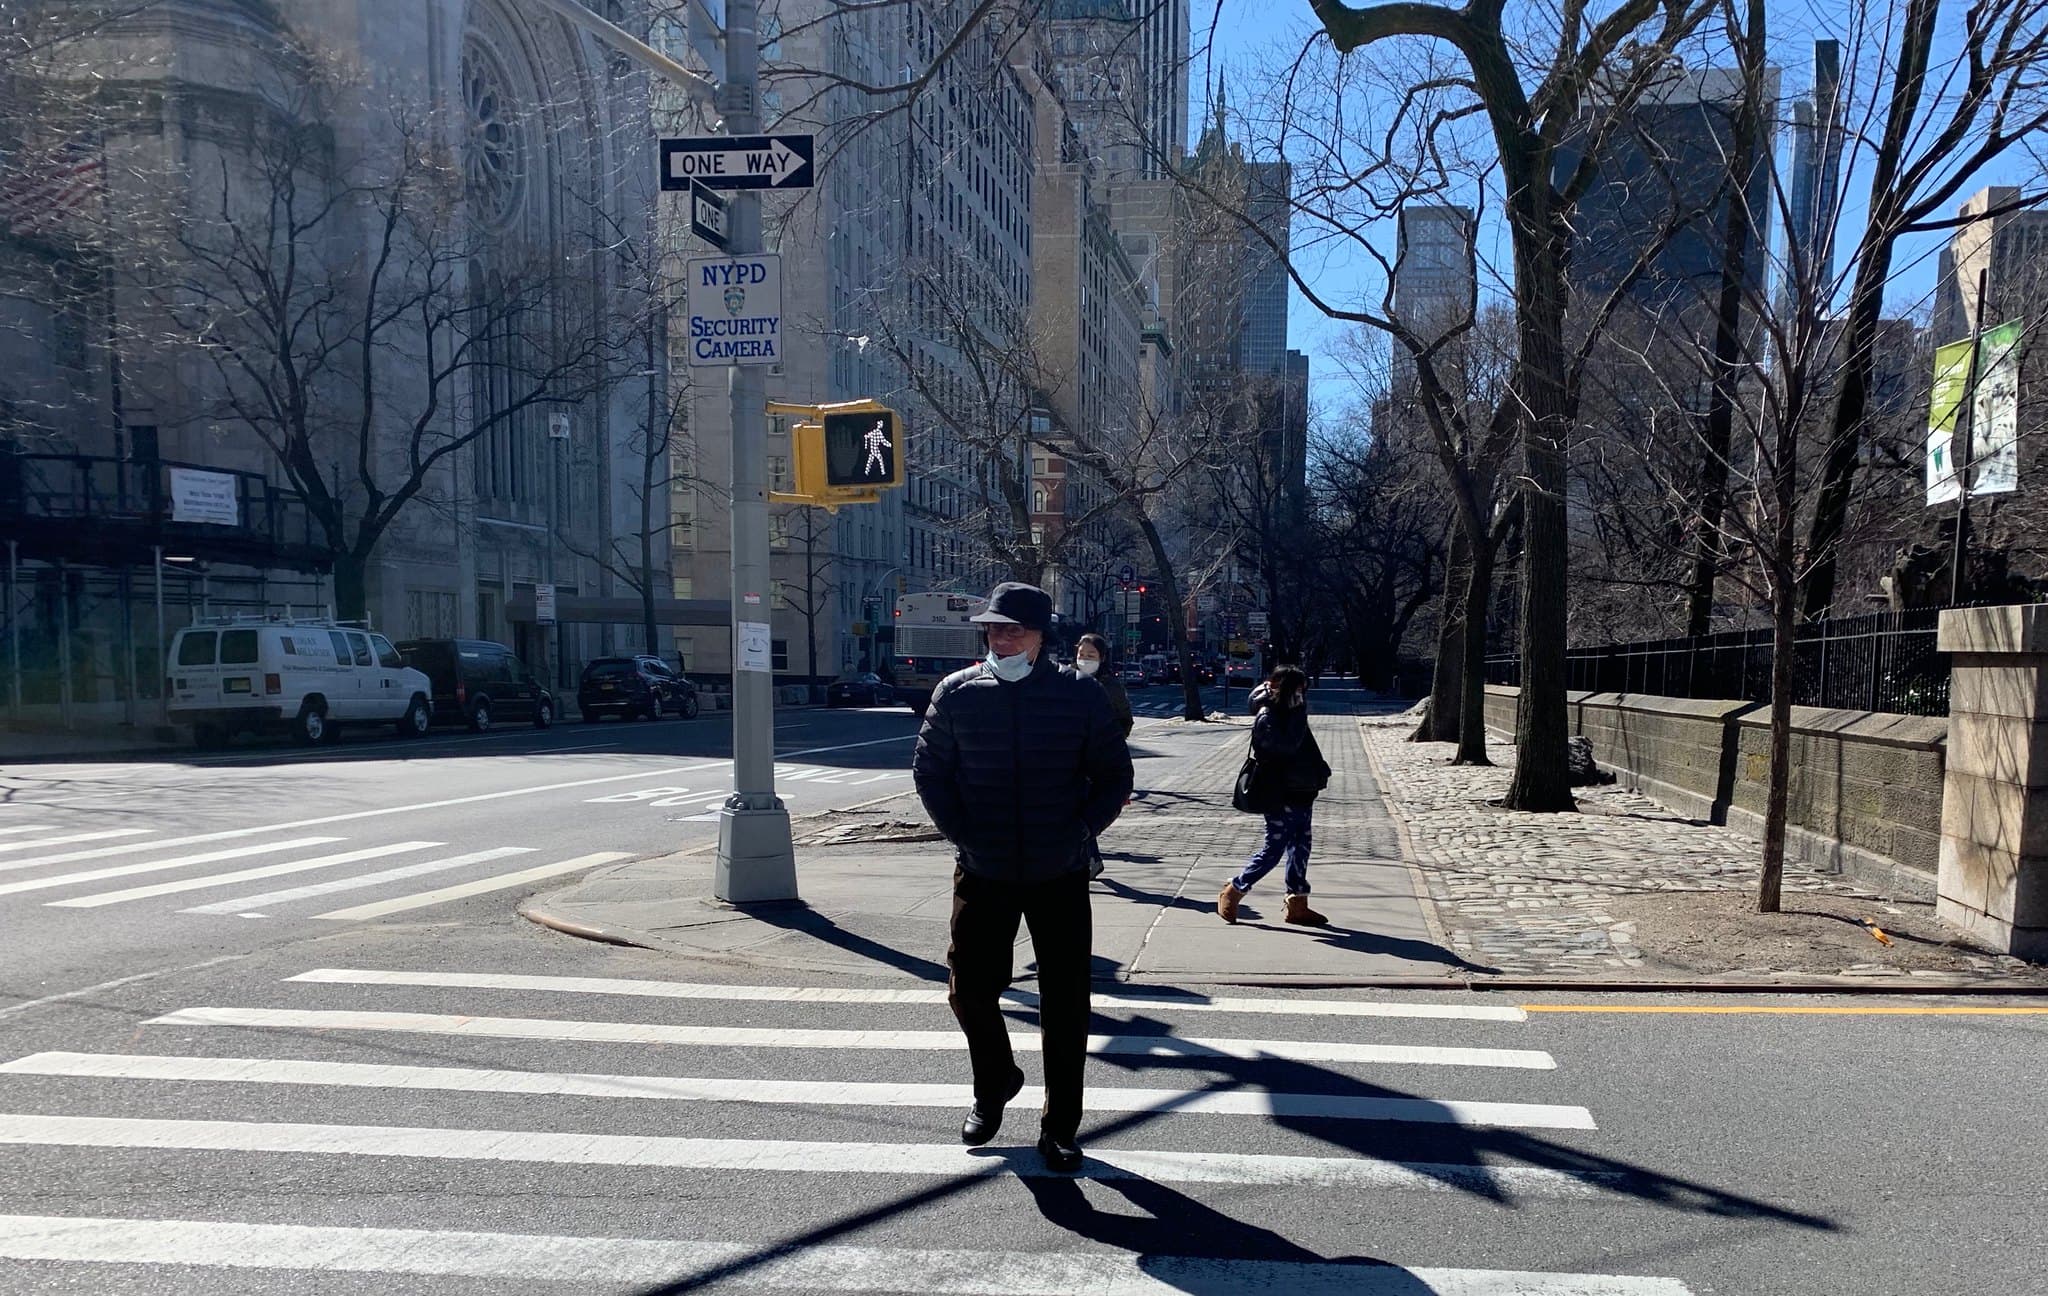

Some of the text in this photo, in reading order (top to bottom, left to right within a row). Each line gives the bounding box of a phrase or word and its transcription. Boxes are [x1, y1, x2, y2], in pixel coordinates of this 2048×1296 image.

[682, 152, 791, 175] ONE WAY
[700, 203, 720, 232] ONE
[702, 263, 766, 286] NYPD
[691, 316, 779, 337] SECURITY
[696, 338, 776, 359] CAMERA
